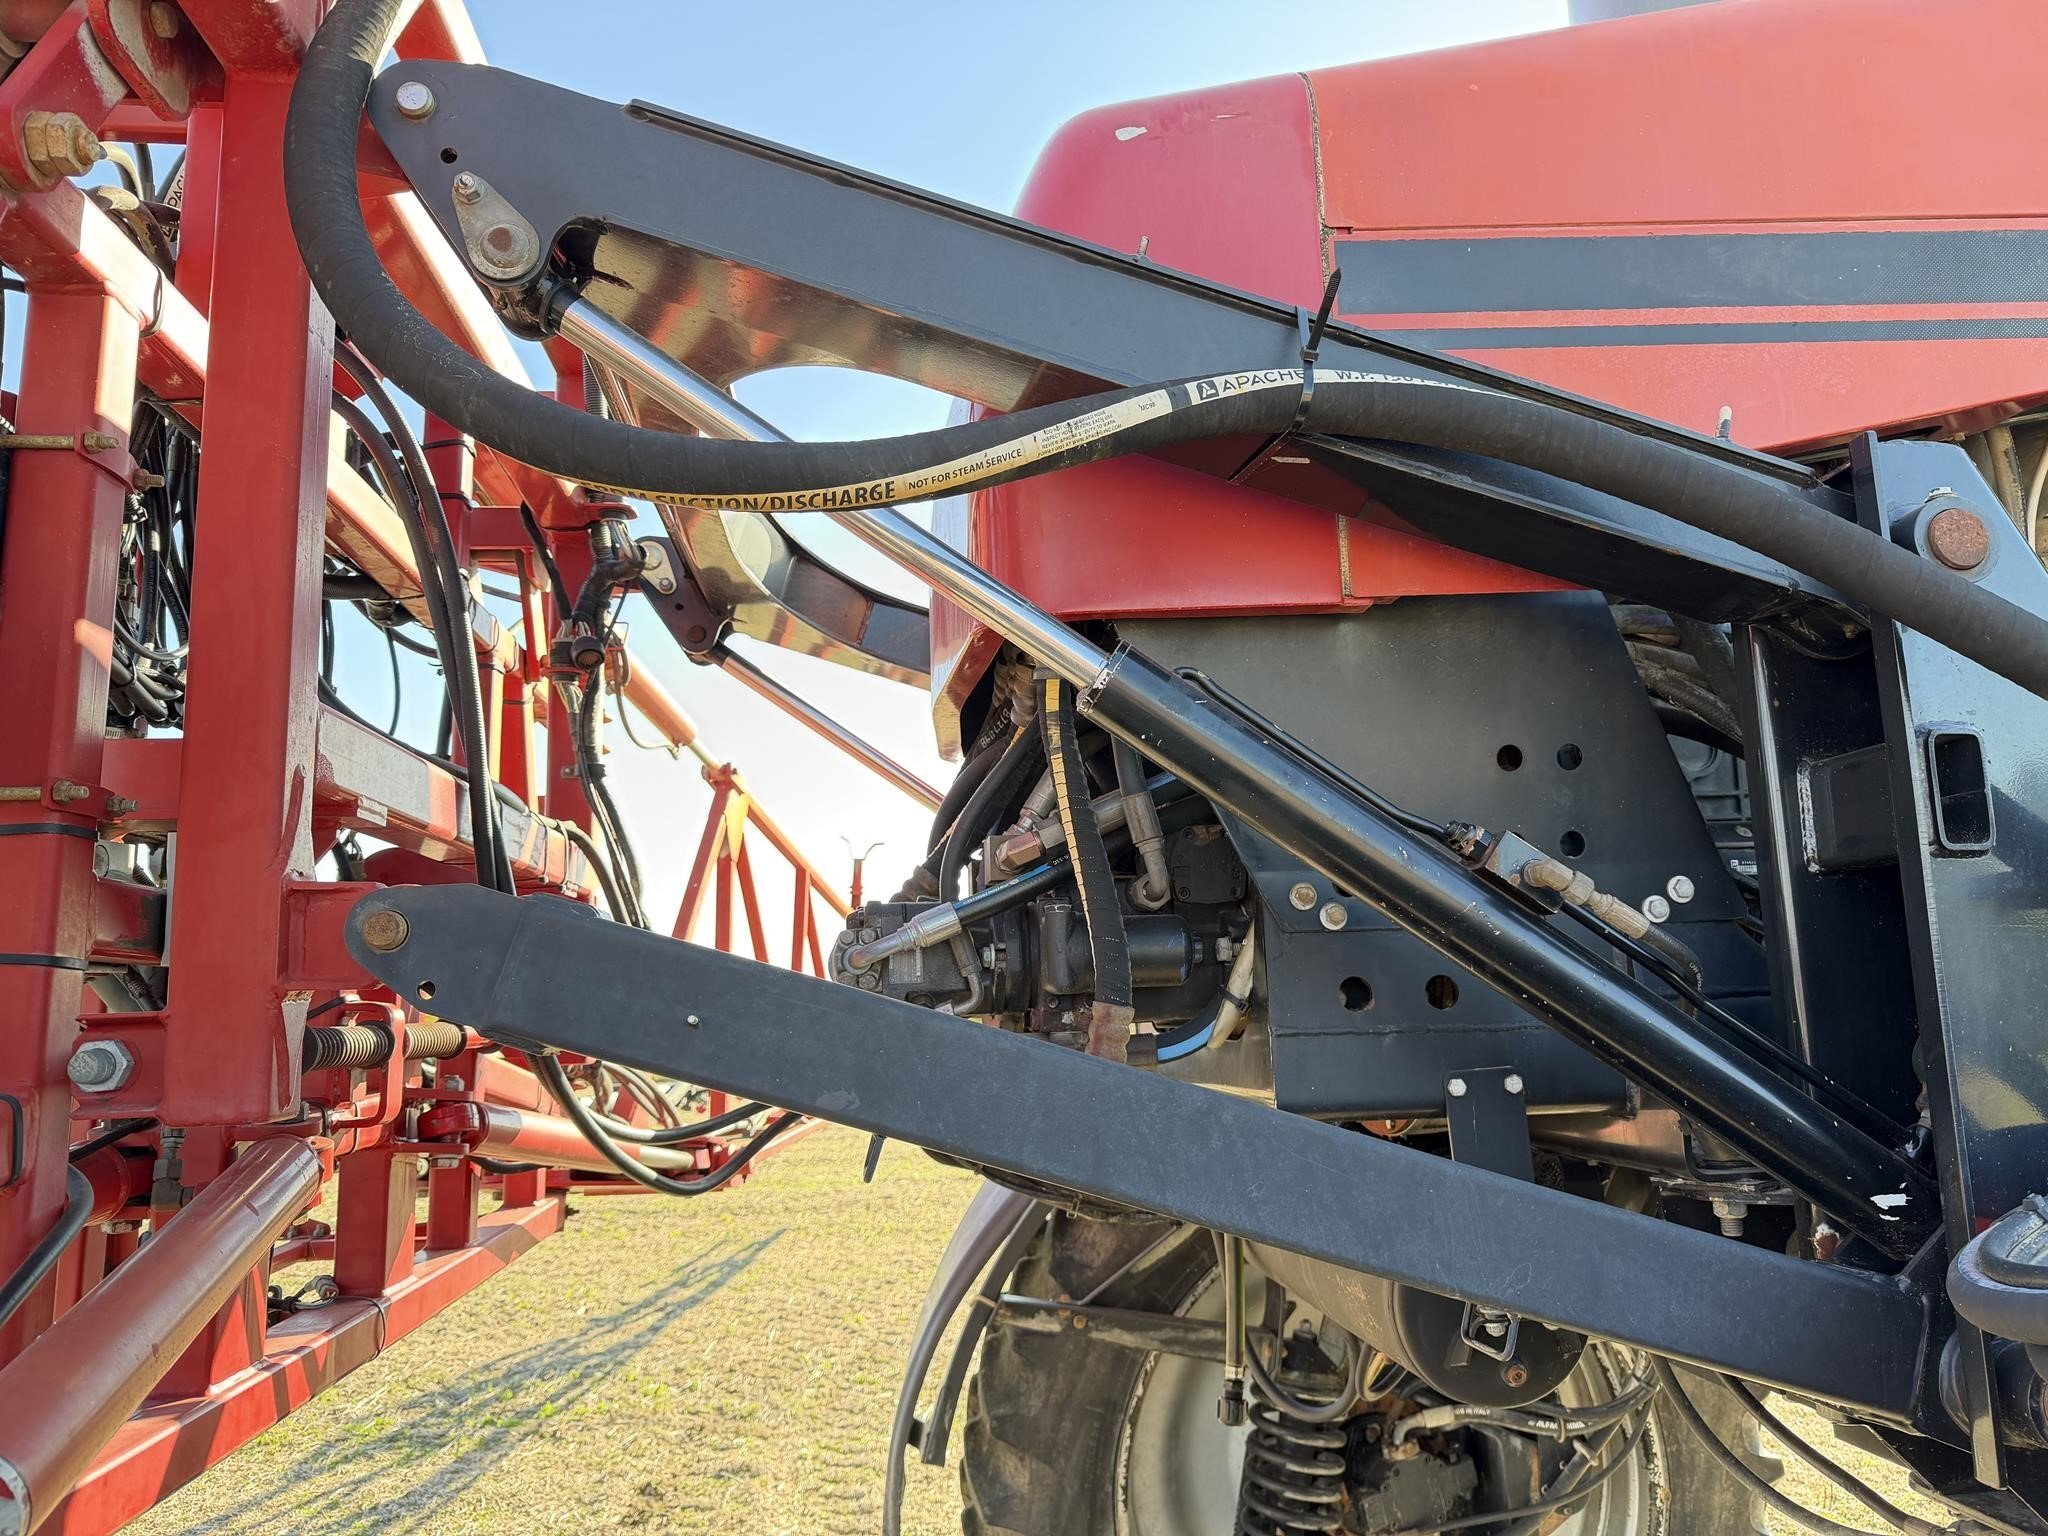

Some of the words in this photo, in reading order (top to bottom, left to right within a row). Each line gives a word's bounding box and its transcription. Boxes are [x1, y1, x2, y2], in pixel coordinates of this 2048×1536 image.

[908, 477, 929, 490] NOT
[931, 472, 951, 485] FOR
[952, 461, 985, 479] STEAM
[986, 448, 1023, 469] SERVICE
